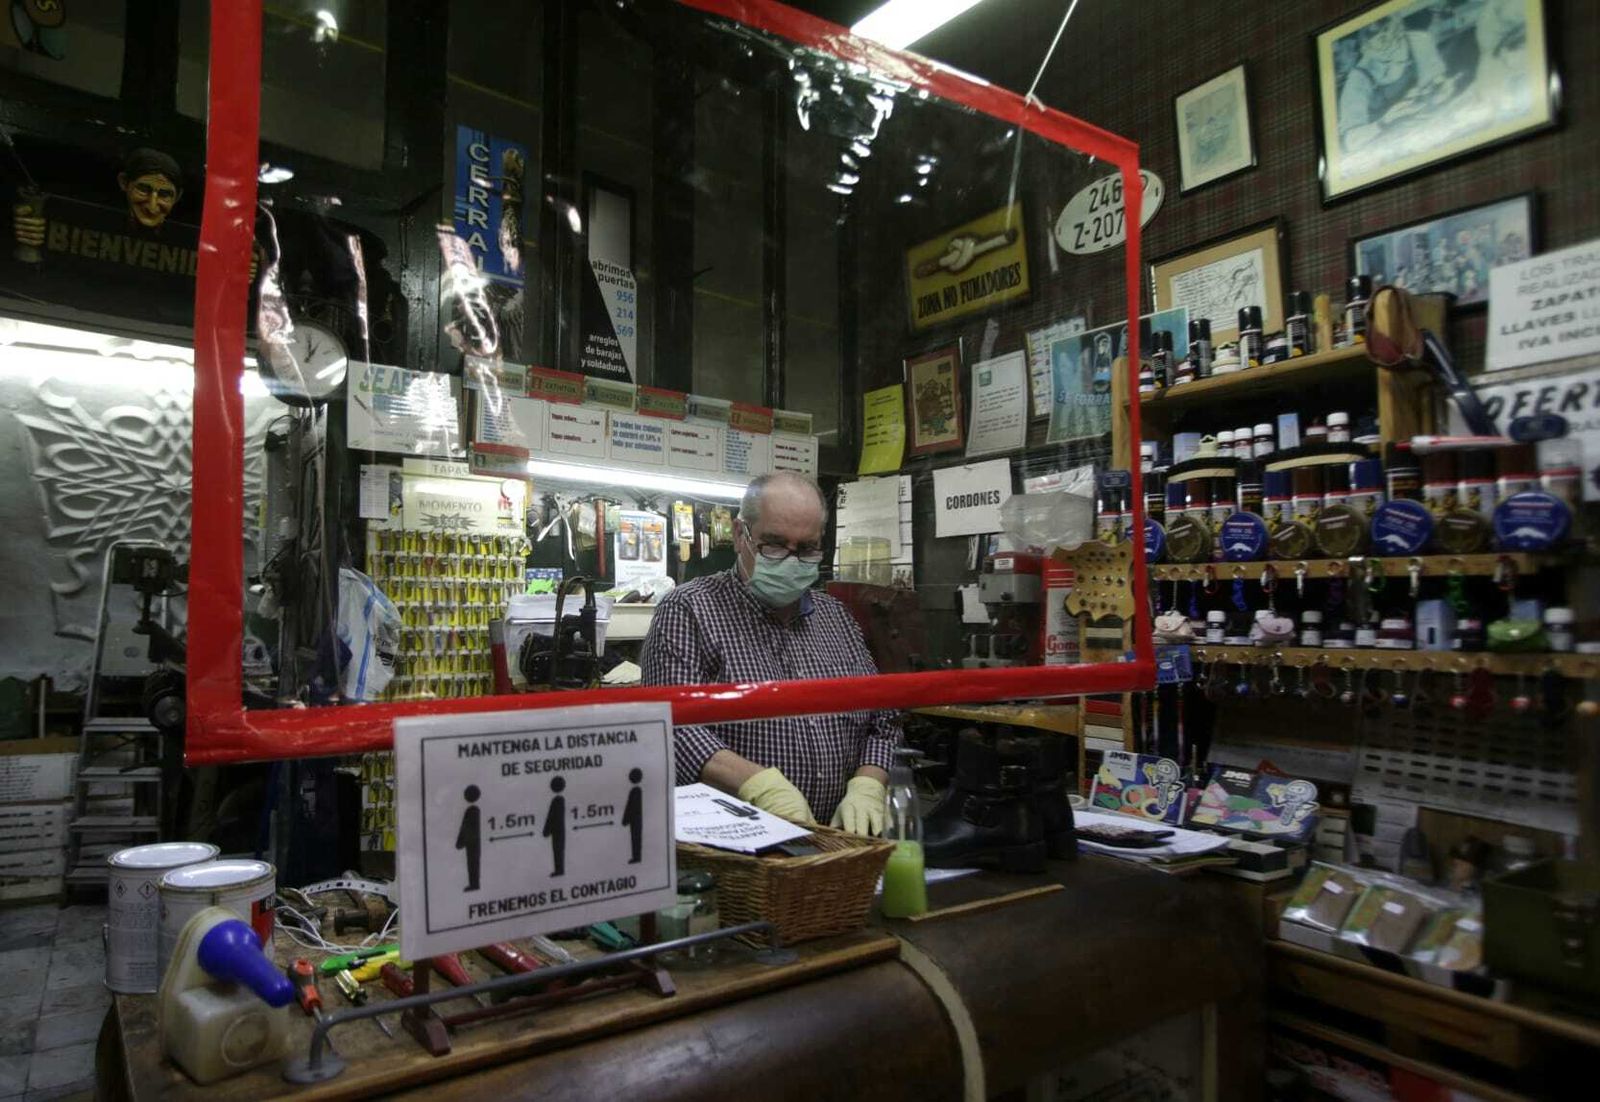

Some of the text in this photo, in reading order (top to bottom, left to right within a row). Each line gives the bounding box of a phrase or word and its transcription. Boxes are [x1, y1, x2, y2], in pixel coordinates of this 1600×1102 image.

[592, 260, 631, 279] abrimos
[1519, 262, 1553, 281] LOS
[598, 273, 635, 290] puertas
[917, 262, 1023, 319] ZONA NO FUMADORES
[1531, 286, 1600, 311] ZAPAT
[616, 307, 634, 320] 214
[1501, 311, 1576, 335] LLAVES
[585, 345, 595, 355] de
[580, 358, 586, 368] y
[432, 464, 469, 477] TAPAS
[418, 498, 483, 513] MOMENTO
[945, 489, 1001, 511] CORDONES
[457, 730, 638, 759] MANTENGA LA DISTANCIA
[501, 755, 603, 777] DE SEGURIDAD
[571, 804, 615, 821] 1.5m
[487, 814, 535, 831] 1.5m
[468, 875, 637, 919] FRENEMOS EL CONTAGIO
